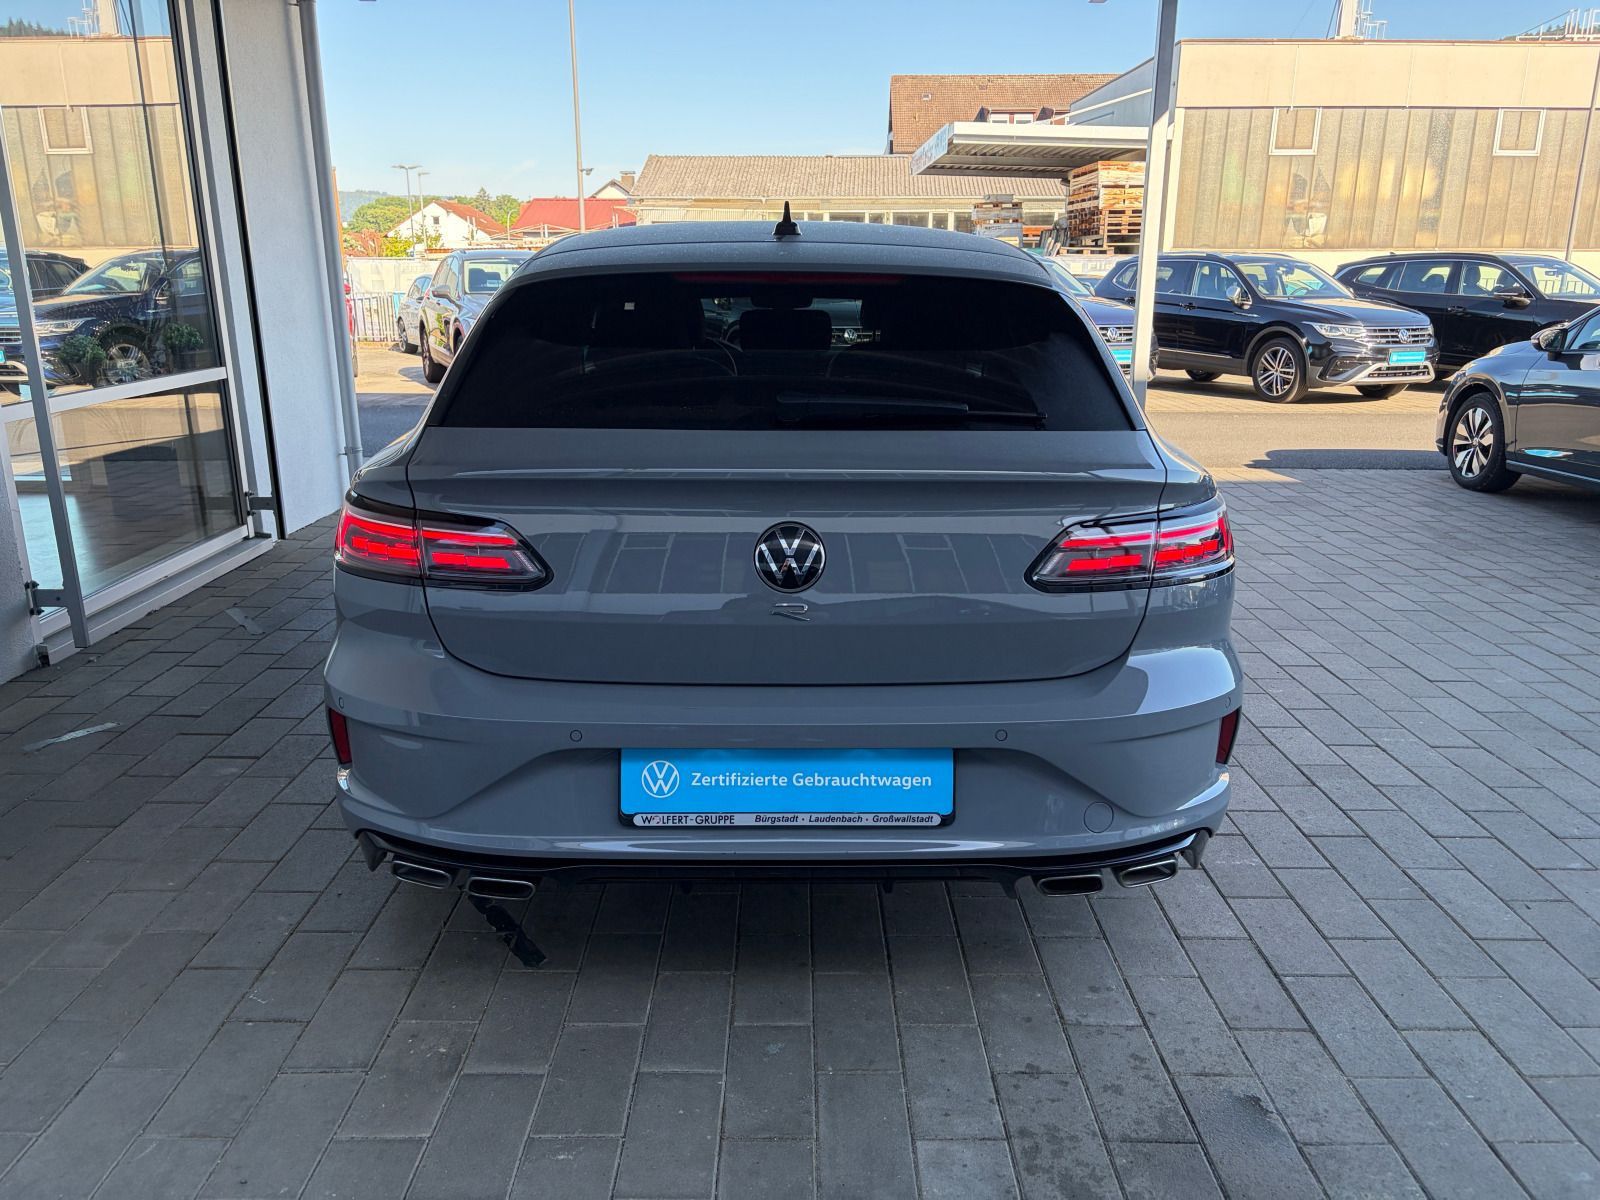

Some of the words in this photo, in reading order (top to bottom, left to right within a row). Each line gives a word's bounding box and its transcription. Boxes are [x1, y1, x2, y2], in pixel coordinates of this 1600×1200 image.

[757, 524, 823, 591] VW
[769, 602, 811, 621] R
[642, 761, 679, 797] VW
[691, 772, 788, 787] Zertifizierte
[792, 772, 932, 790] Gebrauchtwagen
[641, 814, 735, 825] WOLFERT-GRUPPE
[754, 814, 799, 825] Bürgstadt
[808, 814, 863, 824] Laudenbach
[872, 814, 934, 824] Großwallstadt
